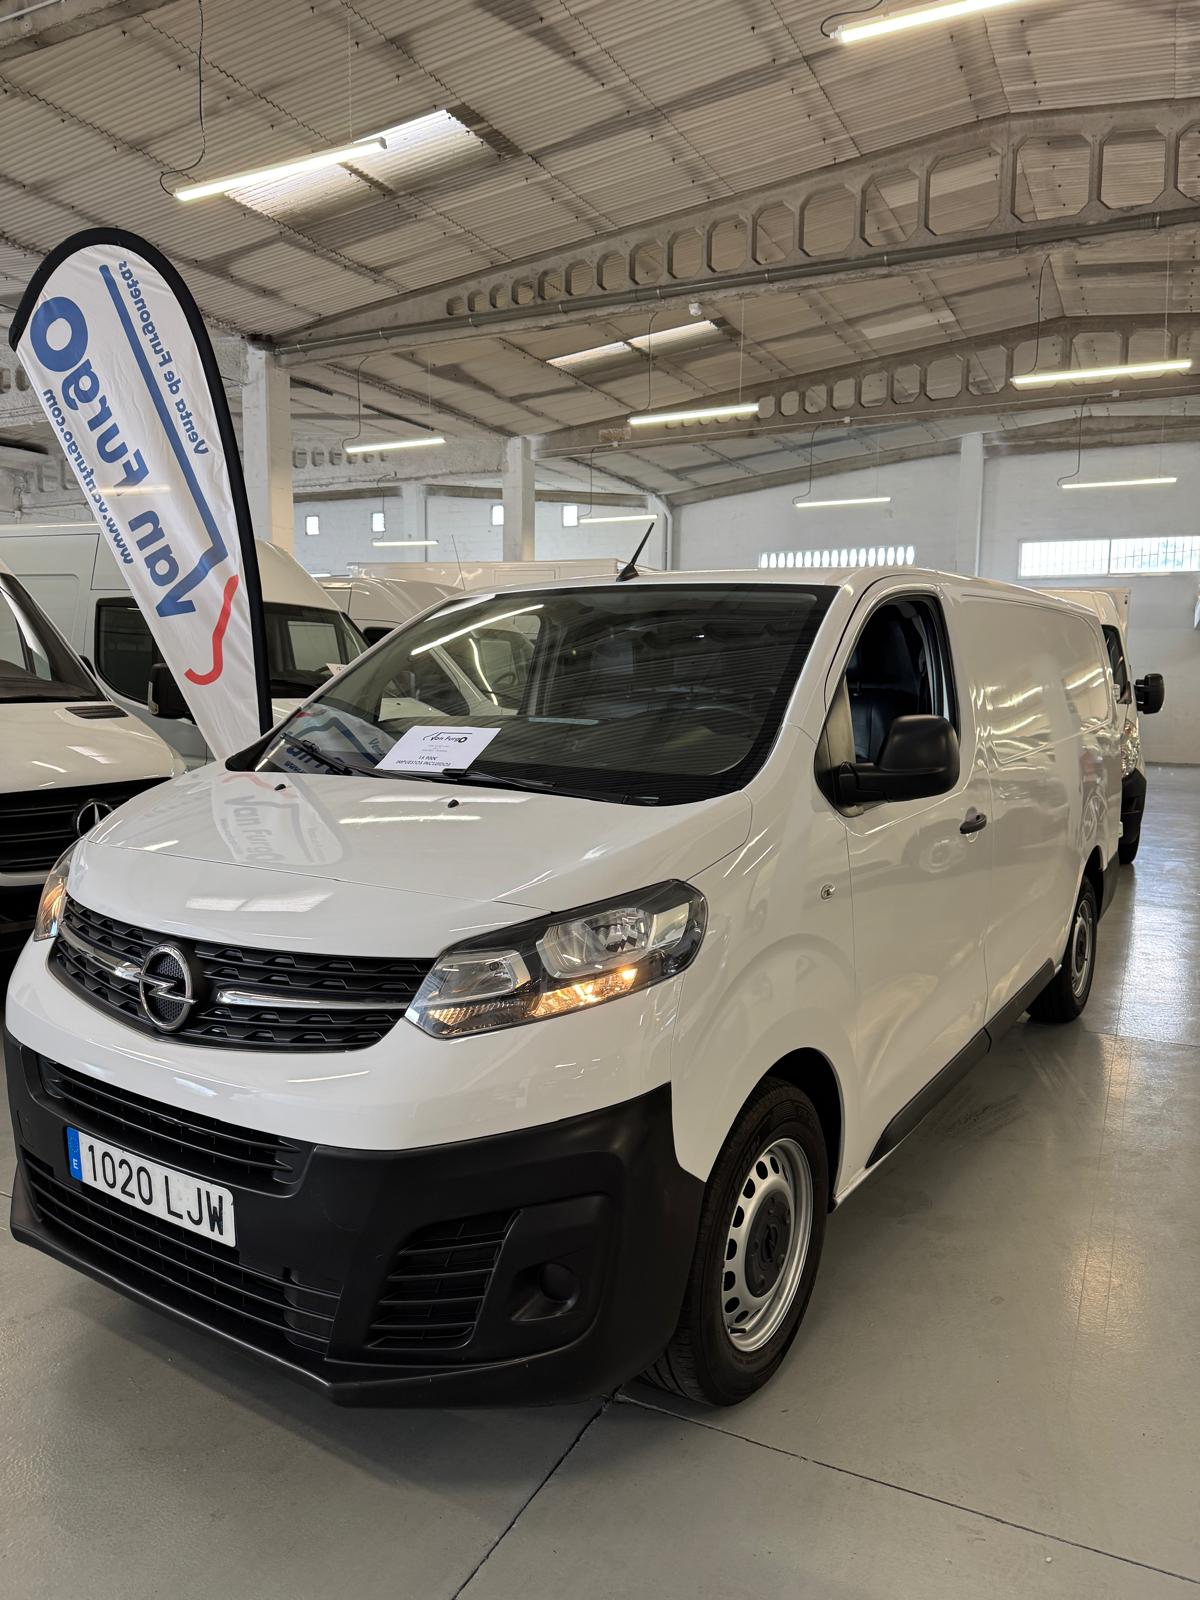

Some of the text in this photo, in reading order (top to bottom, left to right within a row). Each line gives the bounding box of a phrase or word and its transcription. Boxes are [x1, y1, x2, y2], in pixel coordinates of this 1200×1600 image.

[73, 1158, 79, 1170] E
[88, 1144, 224, 1246] 1020 LJW
